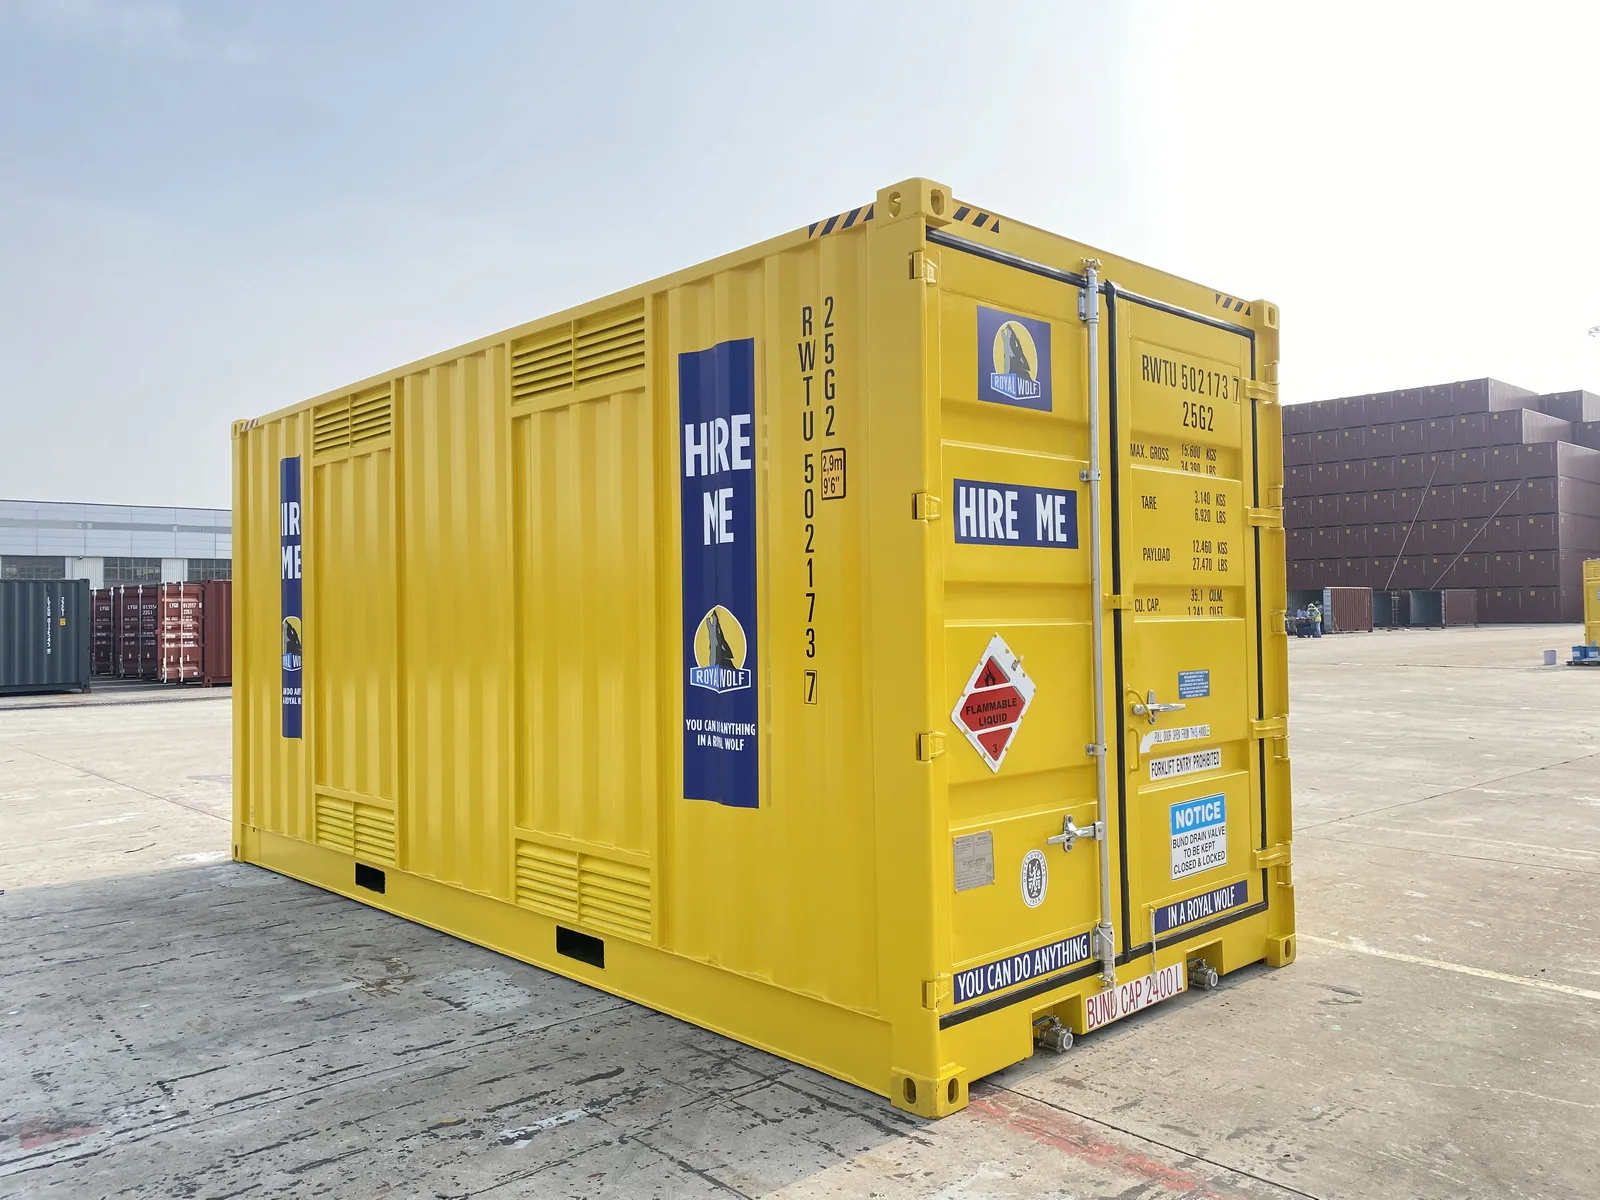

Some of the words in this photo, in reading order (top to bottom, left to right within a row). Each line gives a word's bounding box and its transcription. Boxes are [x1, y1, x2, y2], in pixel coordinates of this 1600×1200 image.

[798, 305, 817, 442] RWTU
[823, 296, 836, 438] 25G2
[1142, 354, 1177, 388] RWTU
[1181, 364, 1229, 400] 502173
[1233, 377, 1240, 402] 7
[994, 375, 1017, 395] ROYAL
[1017, 376, 1038, 396] WOLF
[1182, 401, 1214, 432] 25G2
[684, 413, 752, 477] HIRE
[1130, 443, 1148, 459] MAX.
[1149, 445, 1170, 461] GROSS
[1206, 447, 1217, 462] KGS
[959, 485, 1019, 540] HIRE
[1035, 492, 1067, 542] ME
[1141, 495, 1157, 510] TARE
[1194, 490, 1211, 505] 3.140
[1216, 493, 1226, 507] KGS
[281, 501, 301, 537] IR
[703, 487, 735, 546] ME
[1194, 508, 1211, 523] 6.920
[1216, 510, 1226, 524] LBS
[281, 544, 302, 580] ME
[804, 453, 816, 659] 502173
[1142, 547, 1171, 562] PAYLOAD
[1192, 539, 1212, 554] 12.460
[1217, 541, 1228, 555] KGS
[1192, 557, 1213, 571] 27.470
[1217, 558, 1228, 572] LBS
[1134, 598, 1145, 613] CU.
[1146, 598, 1161, 612] CAP.
[806, 671, 816, 703] 7
[965, 697, 1018, 716] FLAMMABLE
[978, 713, 1008, 727] LIQUID
[685, 718, 703, 731] YOU
[704, 719, 716, 733] CAN
[720, 721, 756, 736] ANYTHING
[697, 734, 706, 746] IN
[706, 735, 712, 747] A
[724, 737, 745, 751] WOLF
[992, 743, 998, 753] 3
[1151, 758, 1175, 778] FORKLIFT
[1176, 756, 1192, 773] ENTRY
[1193, 751, 1220, 770] PROHIBITED
[1175, 801, 1222, 829] NOTICE
[1172, 835, 1189, 849] BUND
[1189, 830, 1207, 844] DRAIN
[1207, 825, 1226, 839] VALVE
[1183, 847, 1192, 858] TO
[1192, 845, 1200, 856] BE
[1201, 840, 1216, 853] KEPT
[1173, 859, 1196, 875] CLOSED
[1197, 857, 1202, 867] &
[1202, 850, 1226, 866] LOCKED
[1168, 904, 1178, 929] IN
[1179, 902, 1186, 925] A
[1187, 893, 1214, 922] ROYAL
[1213, 885, 1236, 912] WOLF
[957, 968, 984, 1001] YOU
[987, 960, 1012, 992] CAN
[1014, 953, 1031, 982] DO
[1033, 934, 1088, 976] ANYTHING
[1086, 990, 1118, 1029] BUND
[1121, 979, 1143, 1015] CAP
[1175, 965, 1183, 992] L
